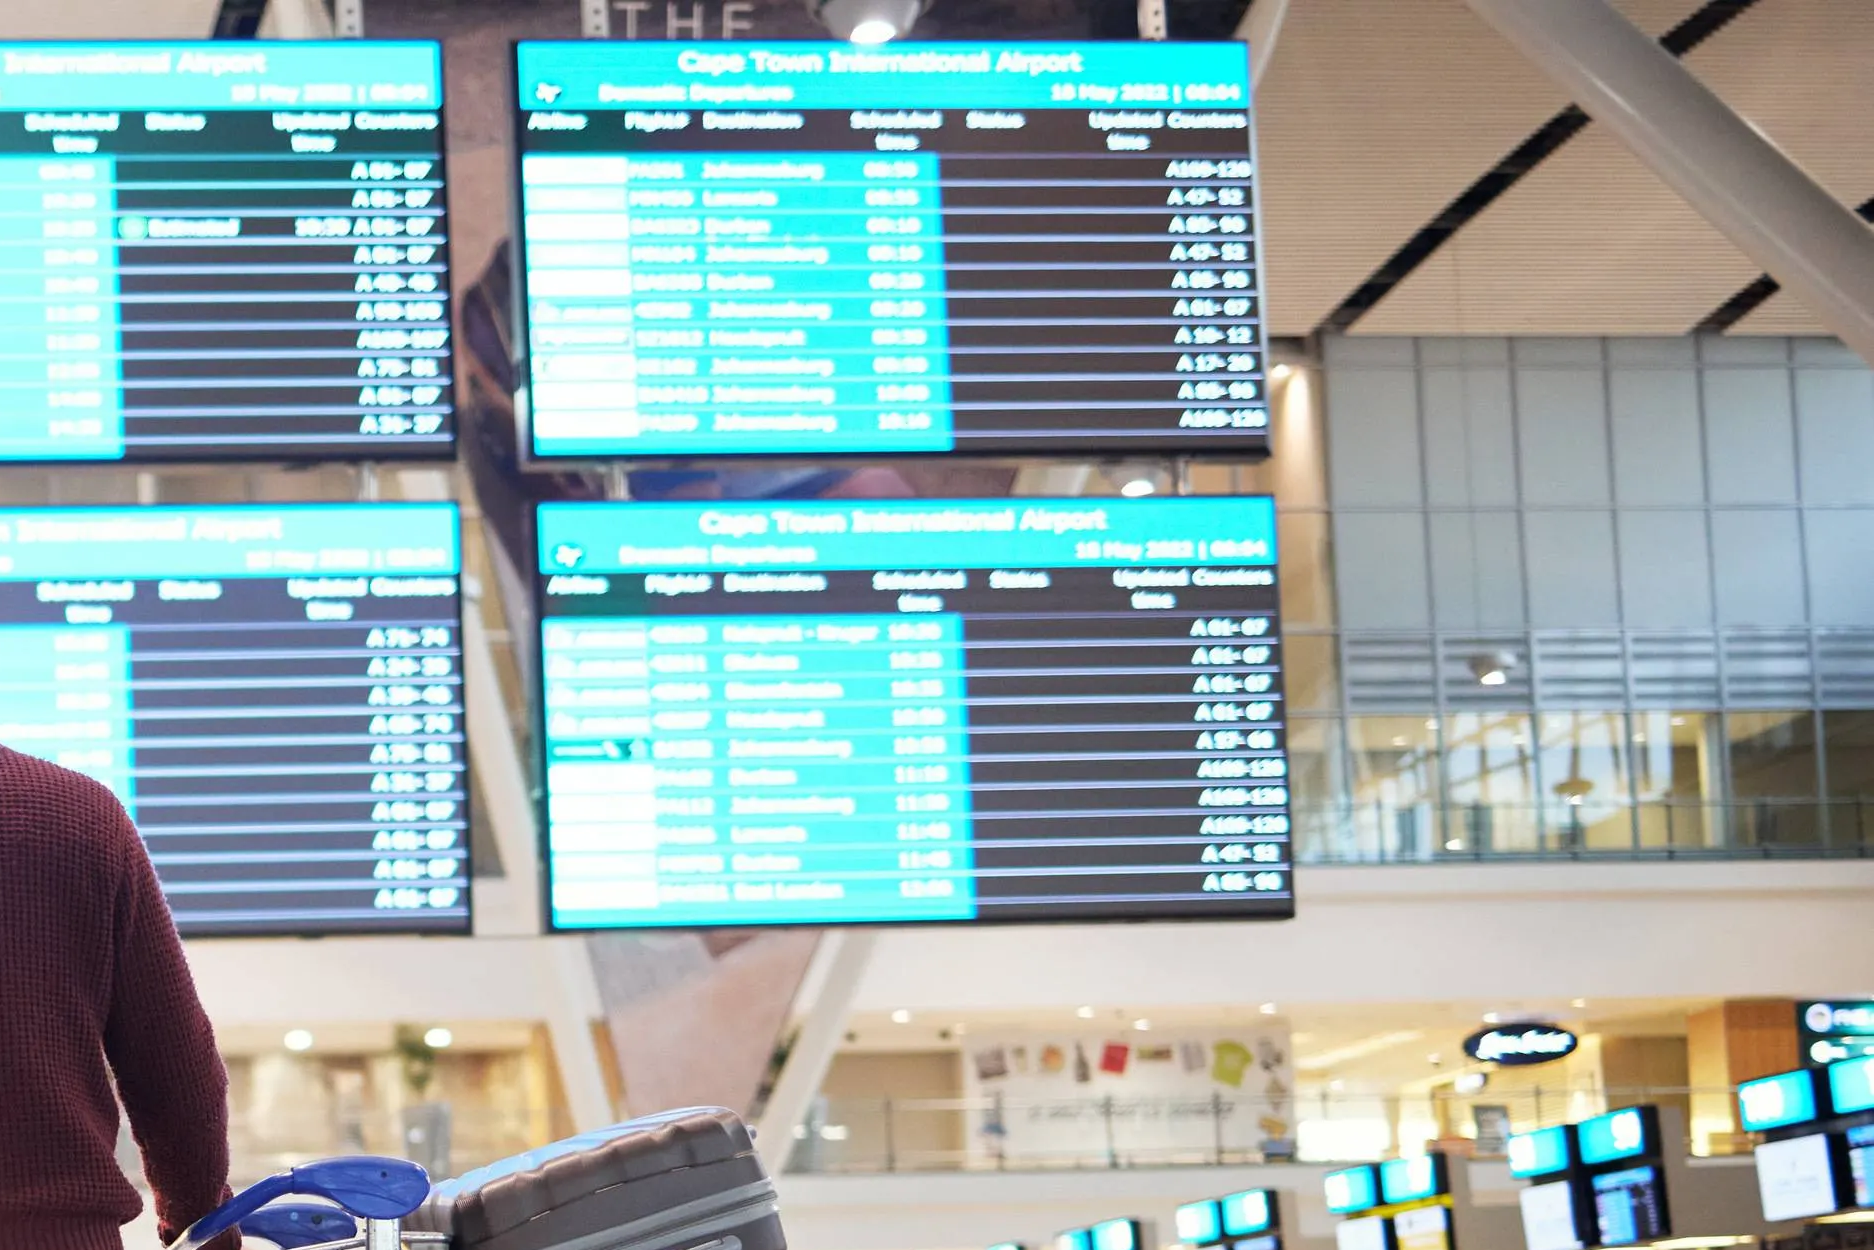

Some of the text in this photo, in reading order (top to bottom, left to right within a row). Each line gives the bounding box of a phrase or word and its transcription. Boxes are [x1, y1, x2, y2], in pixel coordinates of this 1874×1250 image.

[177, 52, 267, 76] Airport
[677, 51, 1083, 76] Cape Town International Airport
[698, 509, 1108, 538] Cape Town International Airport
